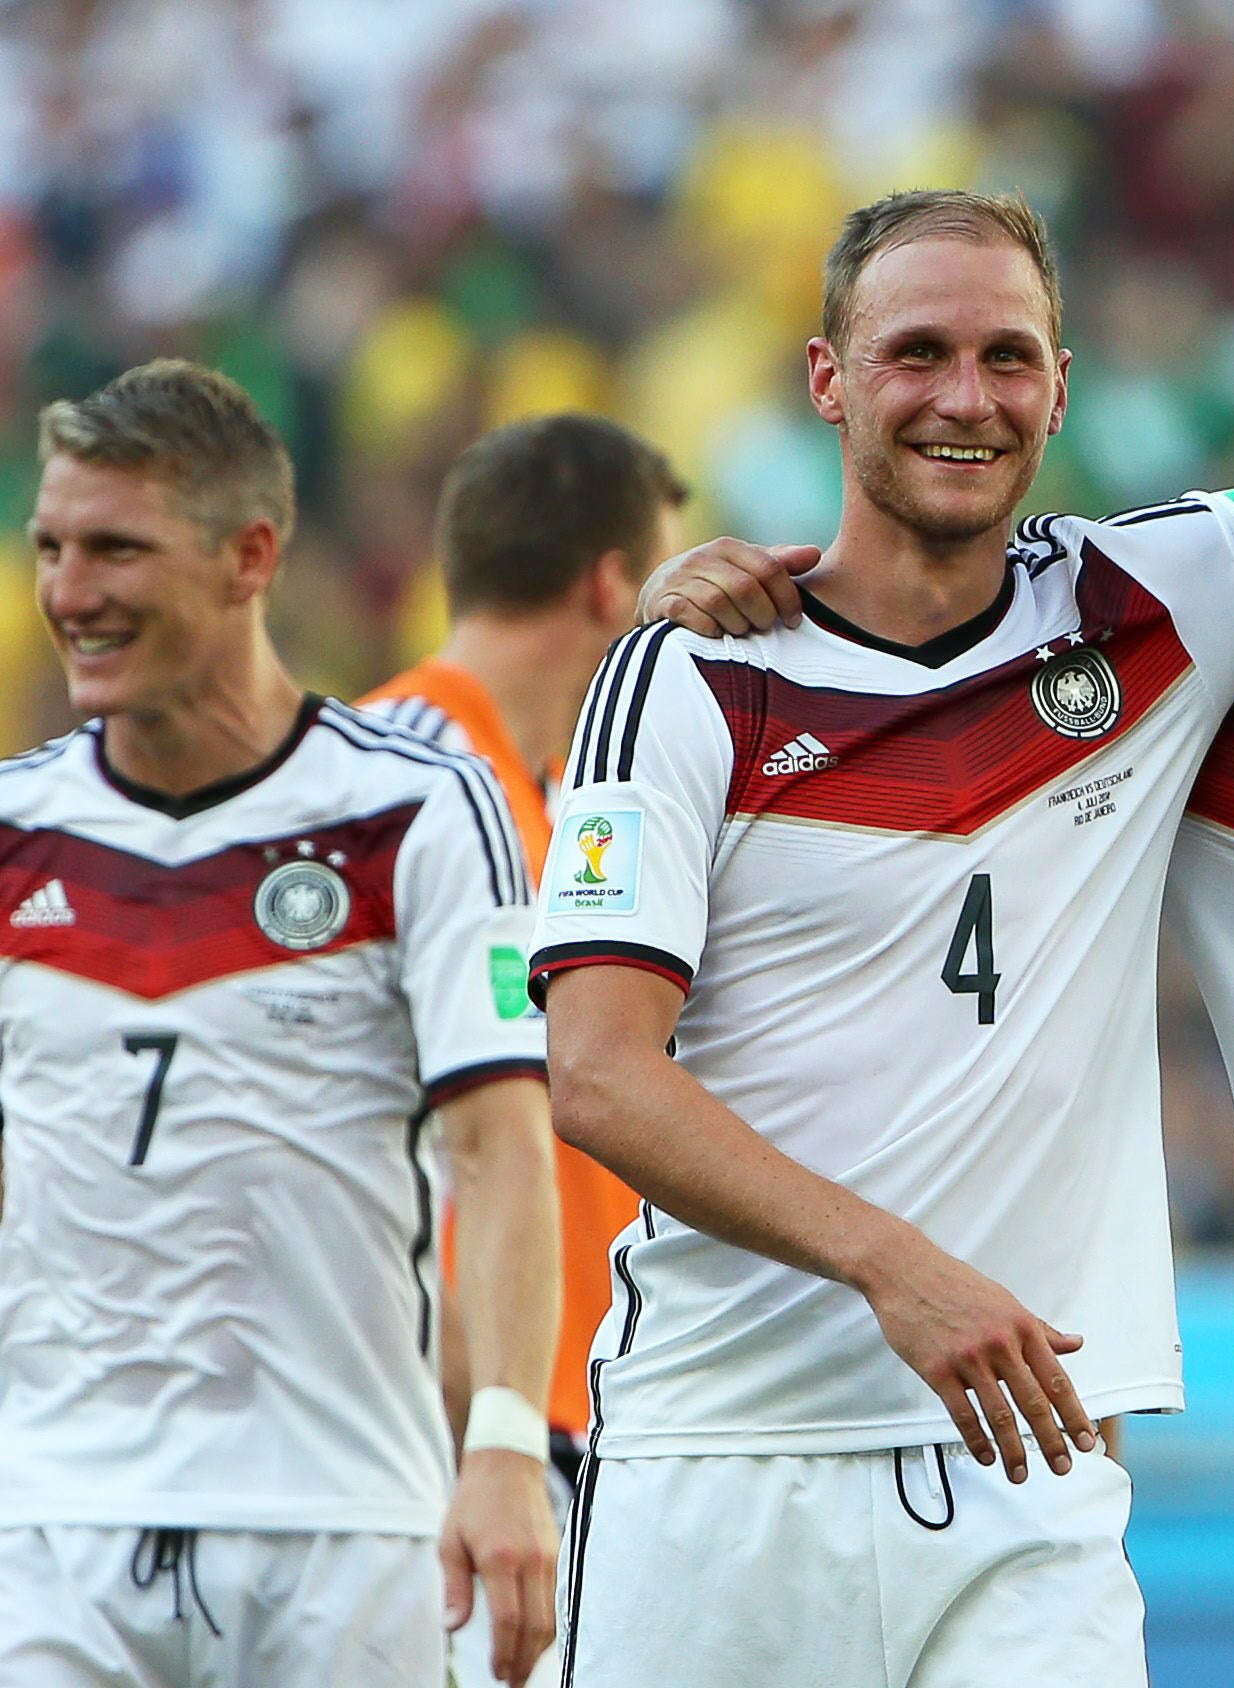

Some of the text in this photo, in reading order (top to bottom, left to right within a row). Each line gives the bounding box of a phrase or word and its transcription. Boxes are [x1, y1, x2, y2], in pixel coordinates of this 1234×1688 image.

[762, 753, 839, 776] adidas
[558, 888, 624, 898] FIFA WORLD CUP
[940, 873, 1002, 1025] 4
[123, 1033, 179, 1166] 7
